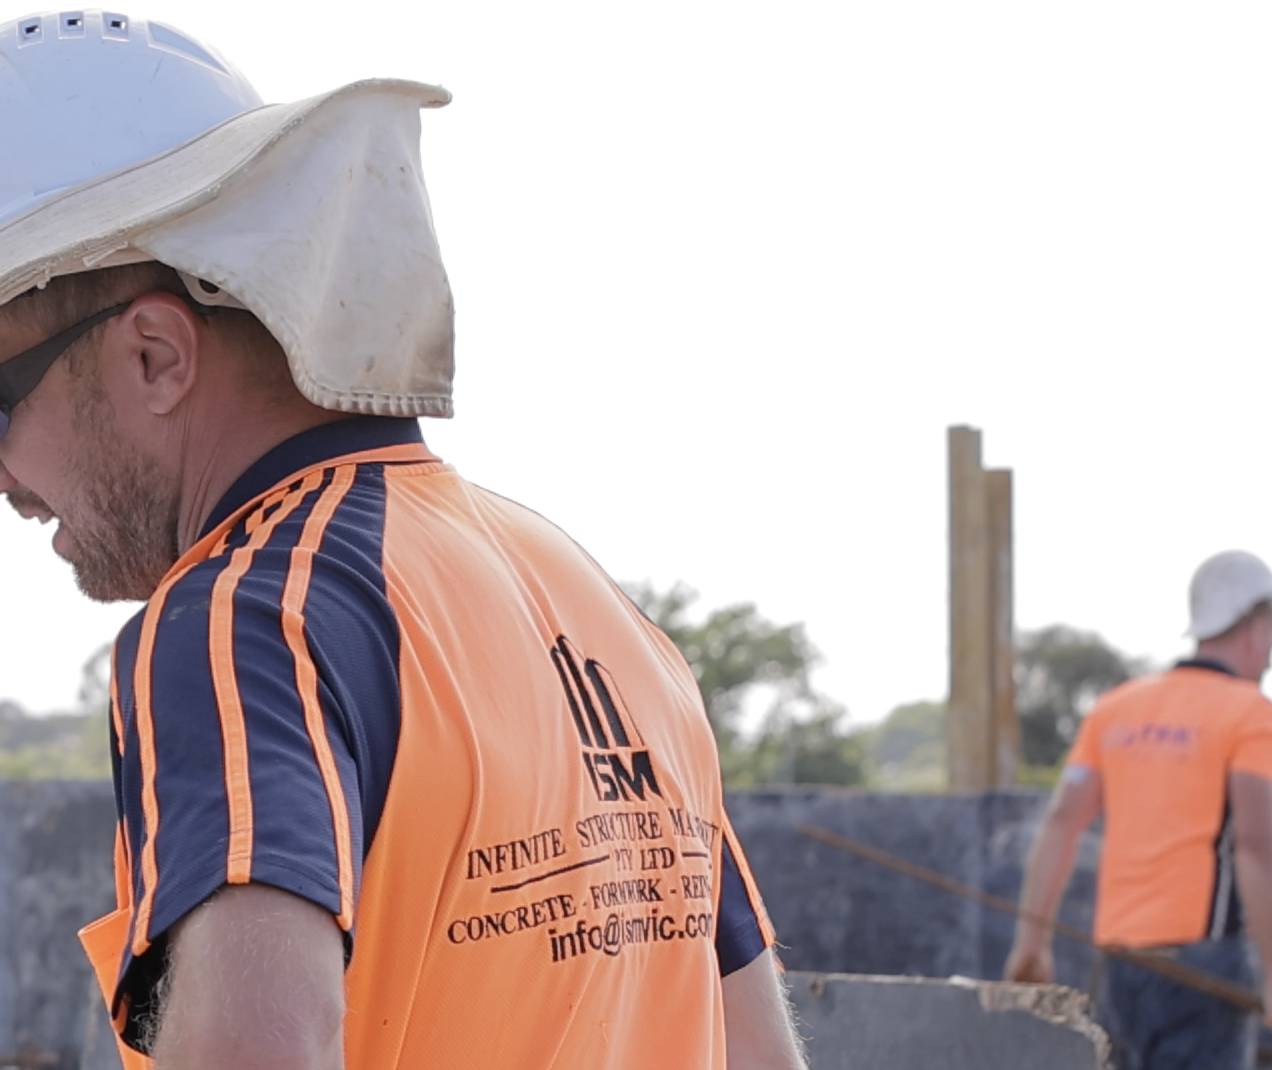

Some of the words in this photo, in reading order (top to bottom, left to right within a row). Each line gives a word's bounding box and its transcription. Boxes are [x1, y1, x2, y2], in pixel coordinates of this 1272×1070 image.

[582, 750, 664, 802] ISM
[466, 828, 566, 880] INFINITE
[640, 846, 675, 871] LTD
[447, 893, 577, 944] CONCRETE
